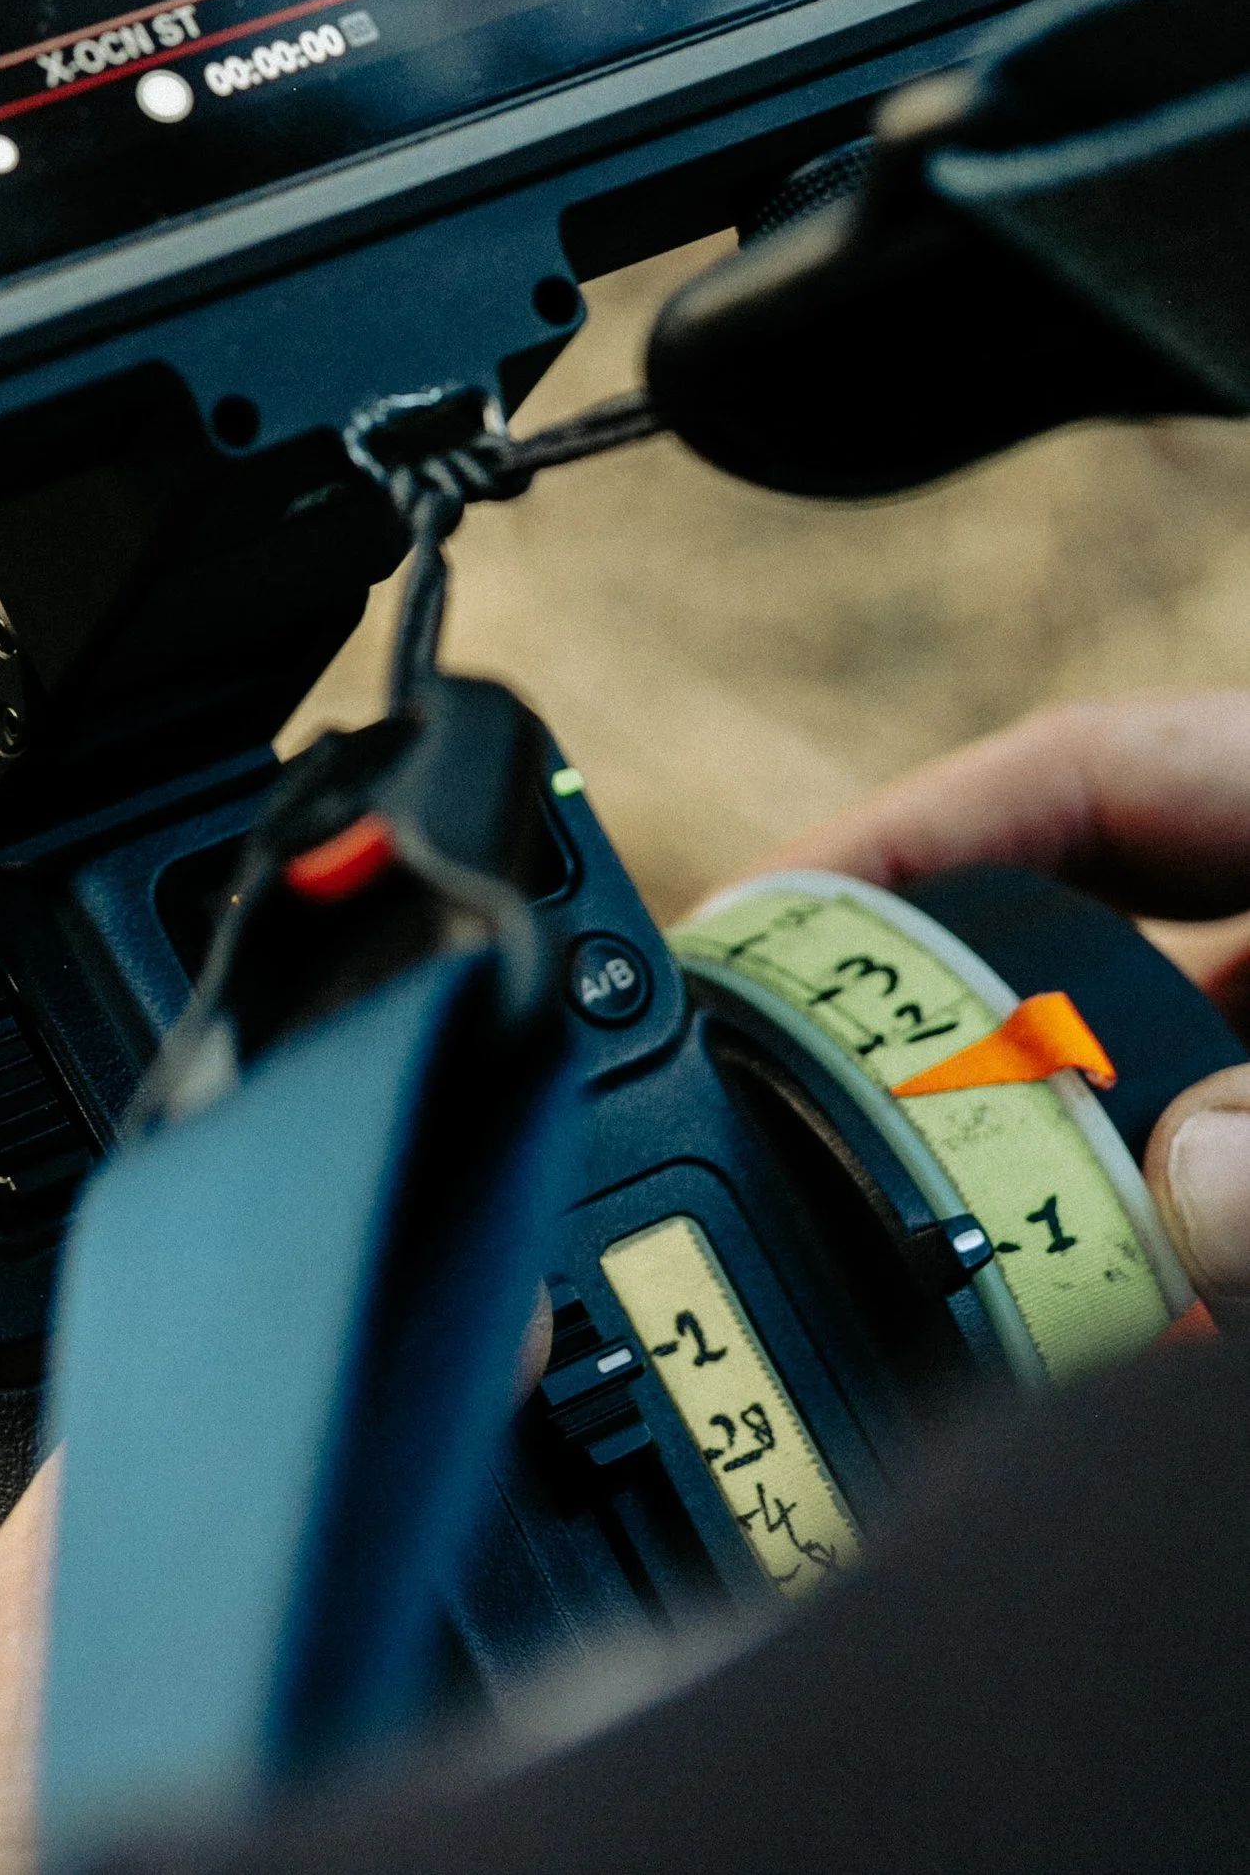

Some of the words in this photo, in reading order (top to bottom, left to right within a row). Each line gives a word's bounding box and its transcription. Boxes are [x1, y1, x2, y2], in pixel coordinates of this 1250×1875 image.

[152, 4, 201, 48] ST
[204, 24, 346, 98] 00:00:00
[581, 957, 636, 1006] A/B
